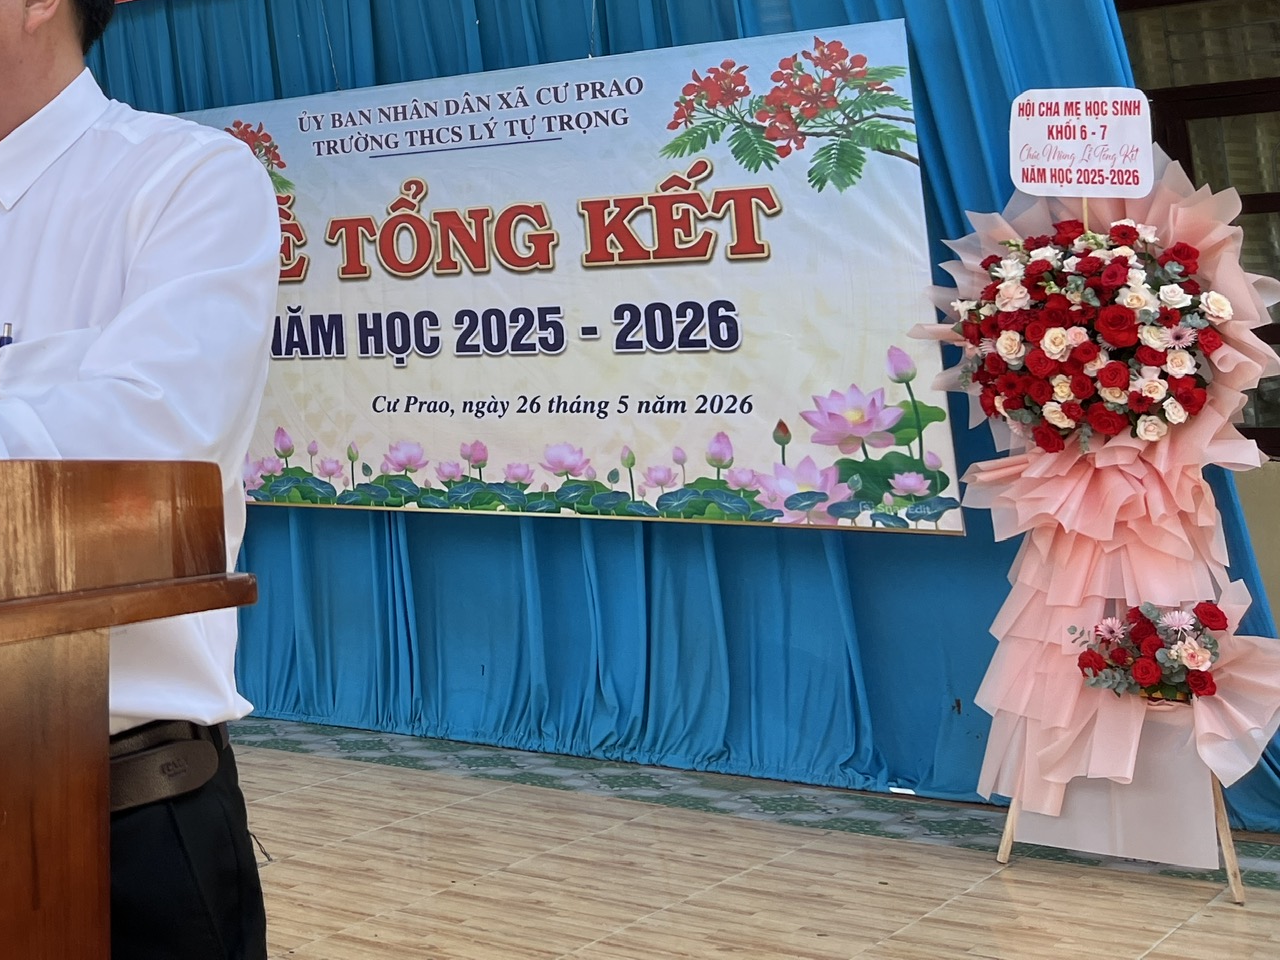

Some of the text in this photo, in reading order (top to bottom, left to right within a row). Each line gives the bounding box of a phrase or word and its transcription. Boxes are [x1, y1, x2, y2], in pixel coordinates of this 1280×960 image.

[298, 76, 644, 132] ỦY BAN NHÂN DÂN XÃ CƯ PRAO
[1018, 99, 1141, 120] HỘI CHA MẸ HỌC SINH
[313, 108, 629, 157] TRƯỜNG THCS LÝ TỰ TRỌNG
[1047, 119, 1076, 140] KHỐI
[1080, 125, 1088, 140] 6
[1100, 125, 1107, 140] 7
[1021, 165, 1140, 187] NĂM HỌC 2025-2026
[277, 157, 781, 280] Ễ TỔNG KẾT
[357, 308, 442, 368] HỌC
[452, 304, 567, 358] 2025
[612, 298, 741, 353] 2026
[372, 394, 754, 419] Cư Prao, ngày 26 tháng 5 năm 2026
[877, 504, 931, 516] SnaEdit
